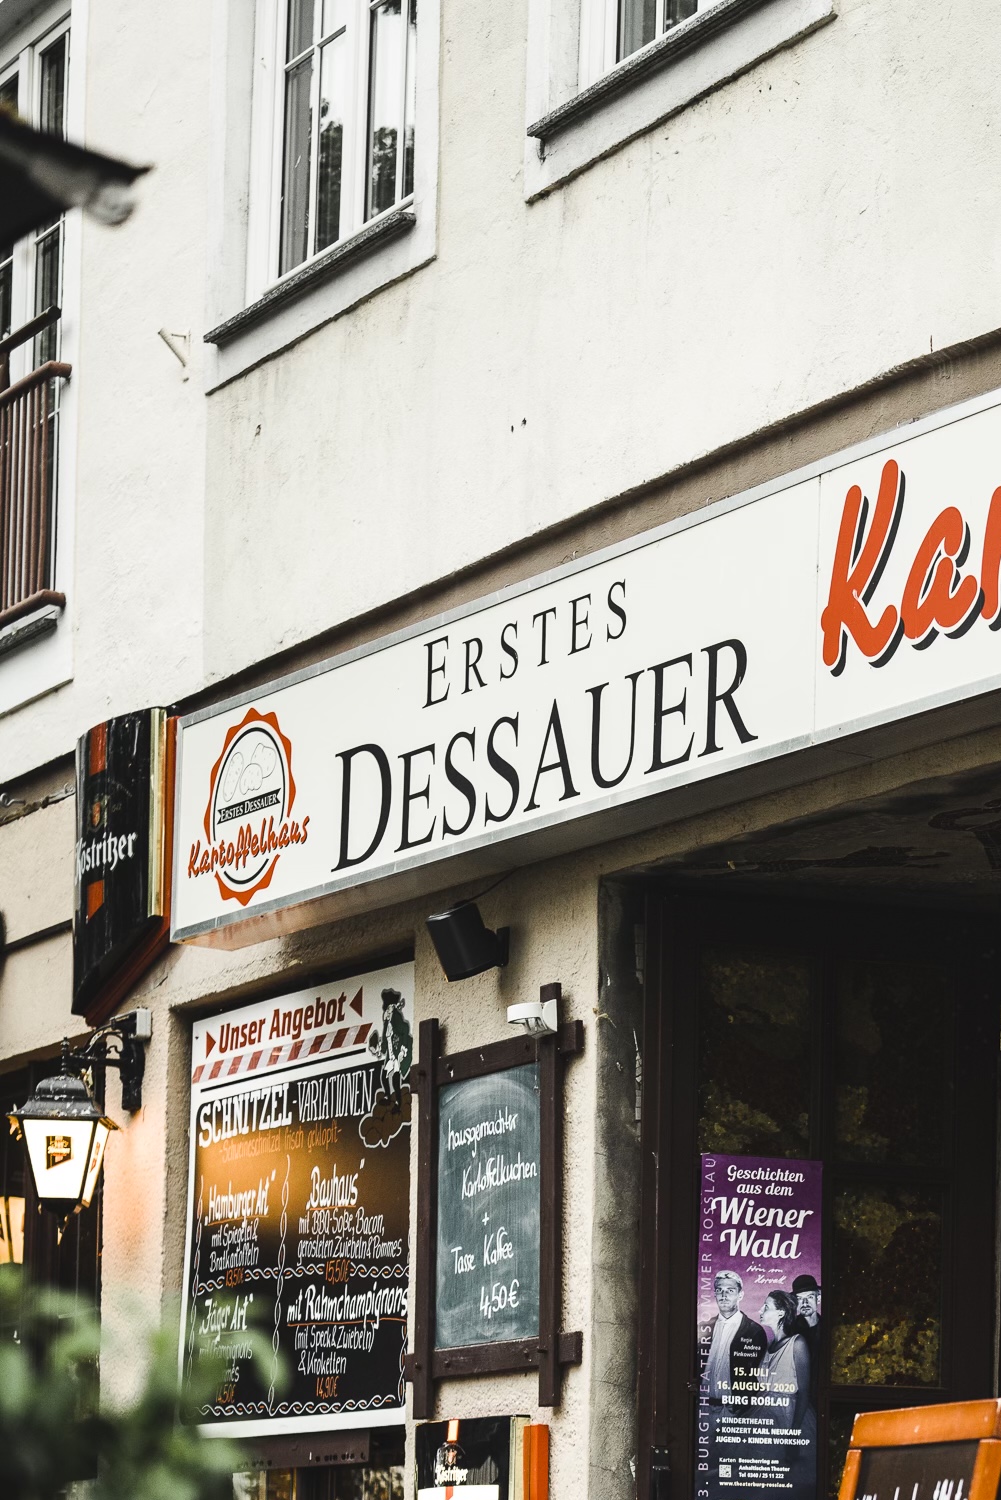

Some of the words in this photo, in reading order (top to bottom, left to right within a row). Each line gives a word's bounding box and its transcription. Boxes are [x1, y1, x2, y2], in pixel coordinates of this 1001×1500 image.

[422, 580, 628, 708] ERSTES
[331, 638, 758, 872] DESSAUER
[220, 805, 243, 822] ERSTES
[244, 793, 278, 814] DESSAUER
[188, 815, 310, 878] Kartoffelhaus
[218, 1018, 266, 1054] Unser
[268, 992, 347, 1040] Angebot
[448, 1106, 518, 1157] hausgemachter
[461, 1152, 538, 1200] Kartoffelkuchen
[727, 1164, 805, 1183] Geschichten
[736, 1183, 762, 1195] aus
[765, 1183, 793, 1196] dem
[299, 1211, 310, 1234] mit
[711, 1196, 814, 1229] Wiener
[211, 1225, 222, 1247] mit
[372, 1235, 402, 1259] Pommes
[719, 1229, 801, 1260] Wald
[210, 1242, 259, 1272] Bratkartoffeln
[451, 1246, 476, 1274] Tasse
[483, 1226, 514, 1268] Kaffee
[325, 1259, 351, 1285] 15,50€
[287, 1288, 302, 1323] mit
[305, 1281, 408, 1330] Rahmchampignons
[479, 1279, 520, 1319] 4,50€
[310, 1325, 332, 1352] Speck
[307, 1351, 347, 1375] Kroketten
[733, 1367, 747, 1376] 15.
[748, 1368, 769, 1377] JULI
[316, 1376, 339, 1399] 14,90€
[717, 1381, 731, 1391] 16.
[732, 1382, 771, 1392] AUGUST
[773, 1383, 796, 1393] 2020
[721, 1395, 749, 1405] BURG
[721, 1417, 774, 1426] KINDERTHEATER
[722, 1427, 752, 1435] KONZERT
[752, 1427, 770, 1435] KARL
[771, 1428, 802, 1436] NEUKAUF
[715, 1436, 741, 1444] JUGEND
[747, 1437, 772, 1445] KINDER
[773, 1438, 810, 1446] WORKSHOP
